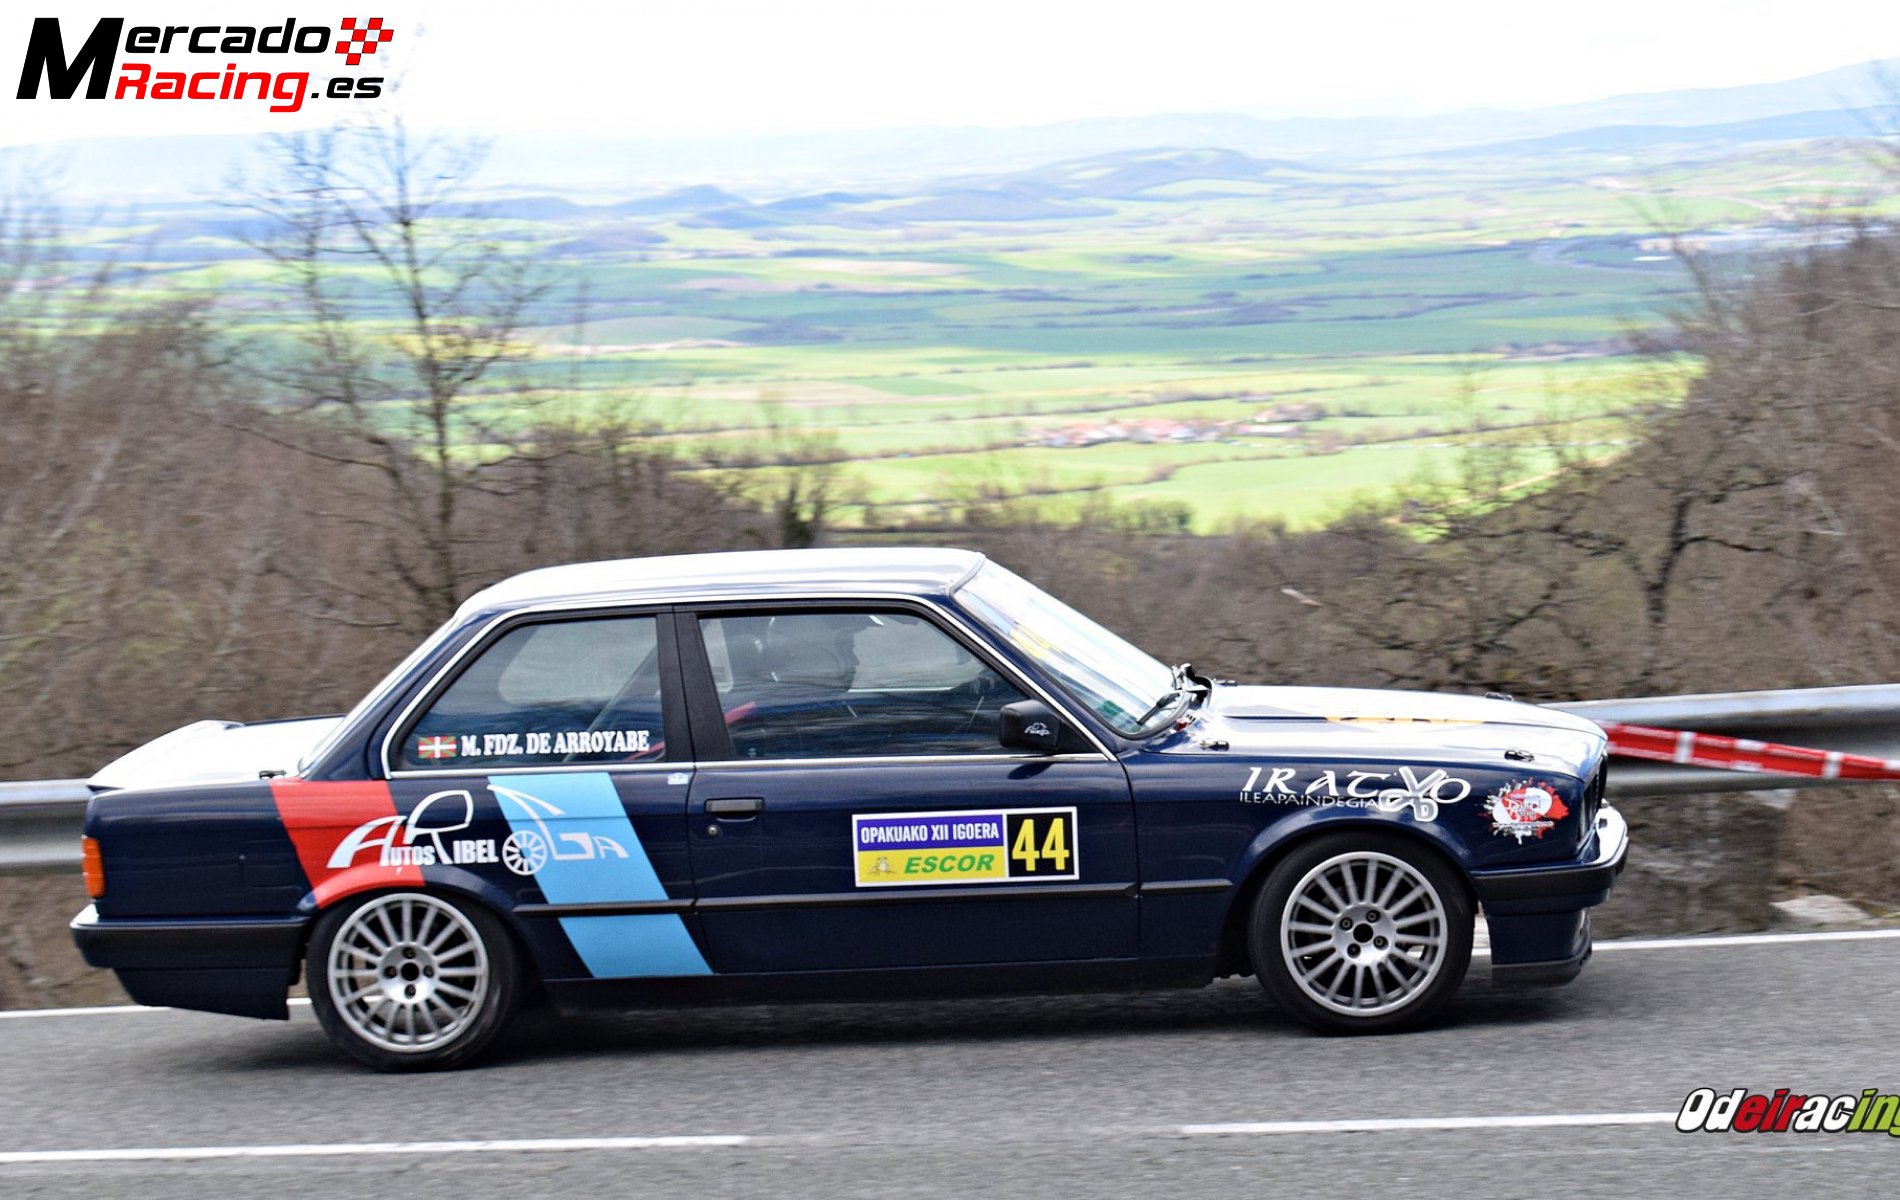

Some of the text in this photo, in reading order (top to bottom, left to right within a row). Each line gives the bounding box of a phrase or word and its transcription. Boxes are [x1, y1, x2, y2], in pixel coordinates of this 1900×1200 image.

[461, 730, 650, 756] M. FDZ. DE ARROYABE
[1239, 791, 1379, 809] ILEAPAINDEGIA
[861, 822, 1000, 844] OPAKUAKO XII IGOERA
[1012, 818, 1069, 871] 44
[904, 854, 995, 874] ESCOR
